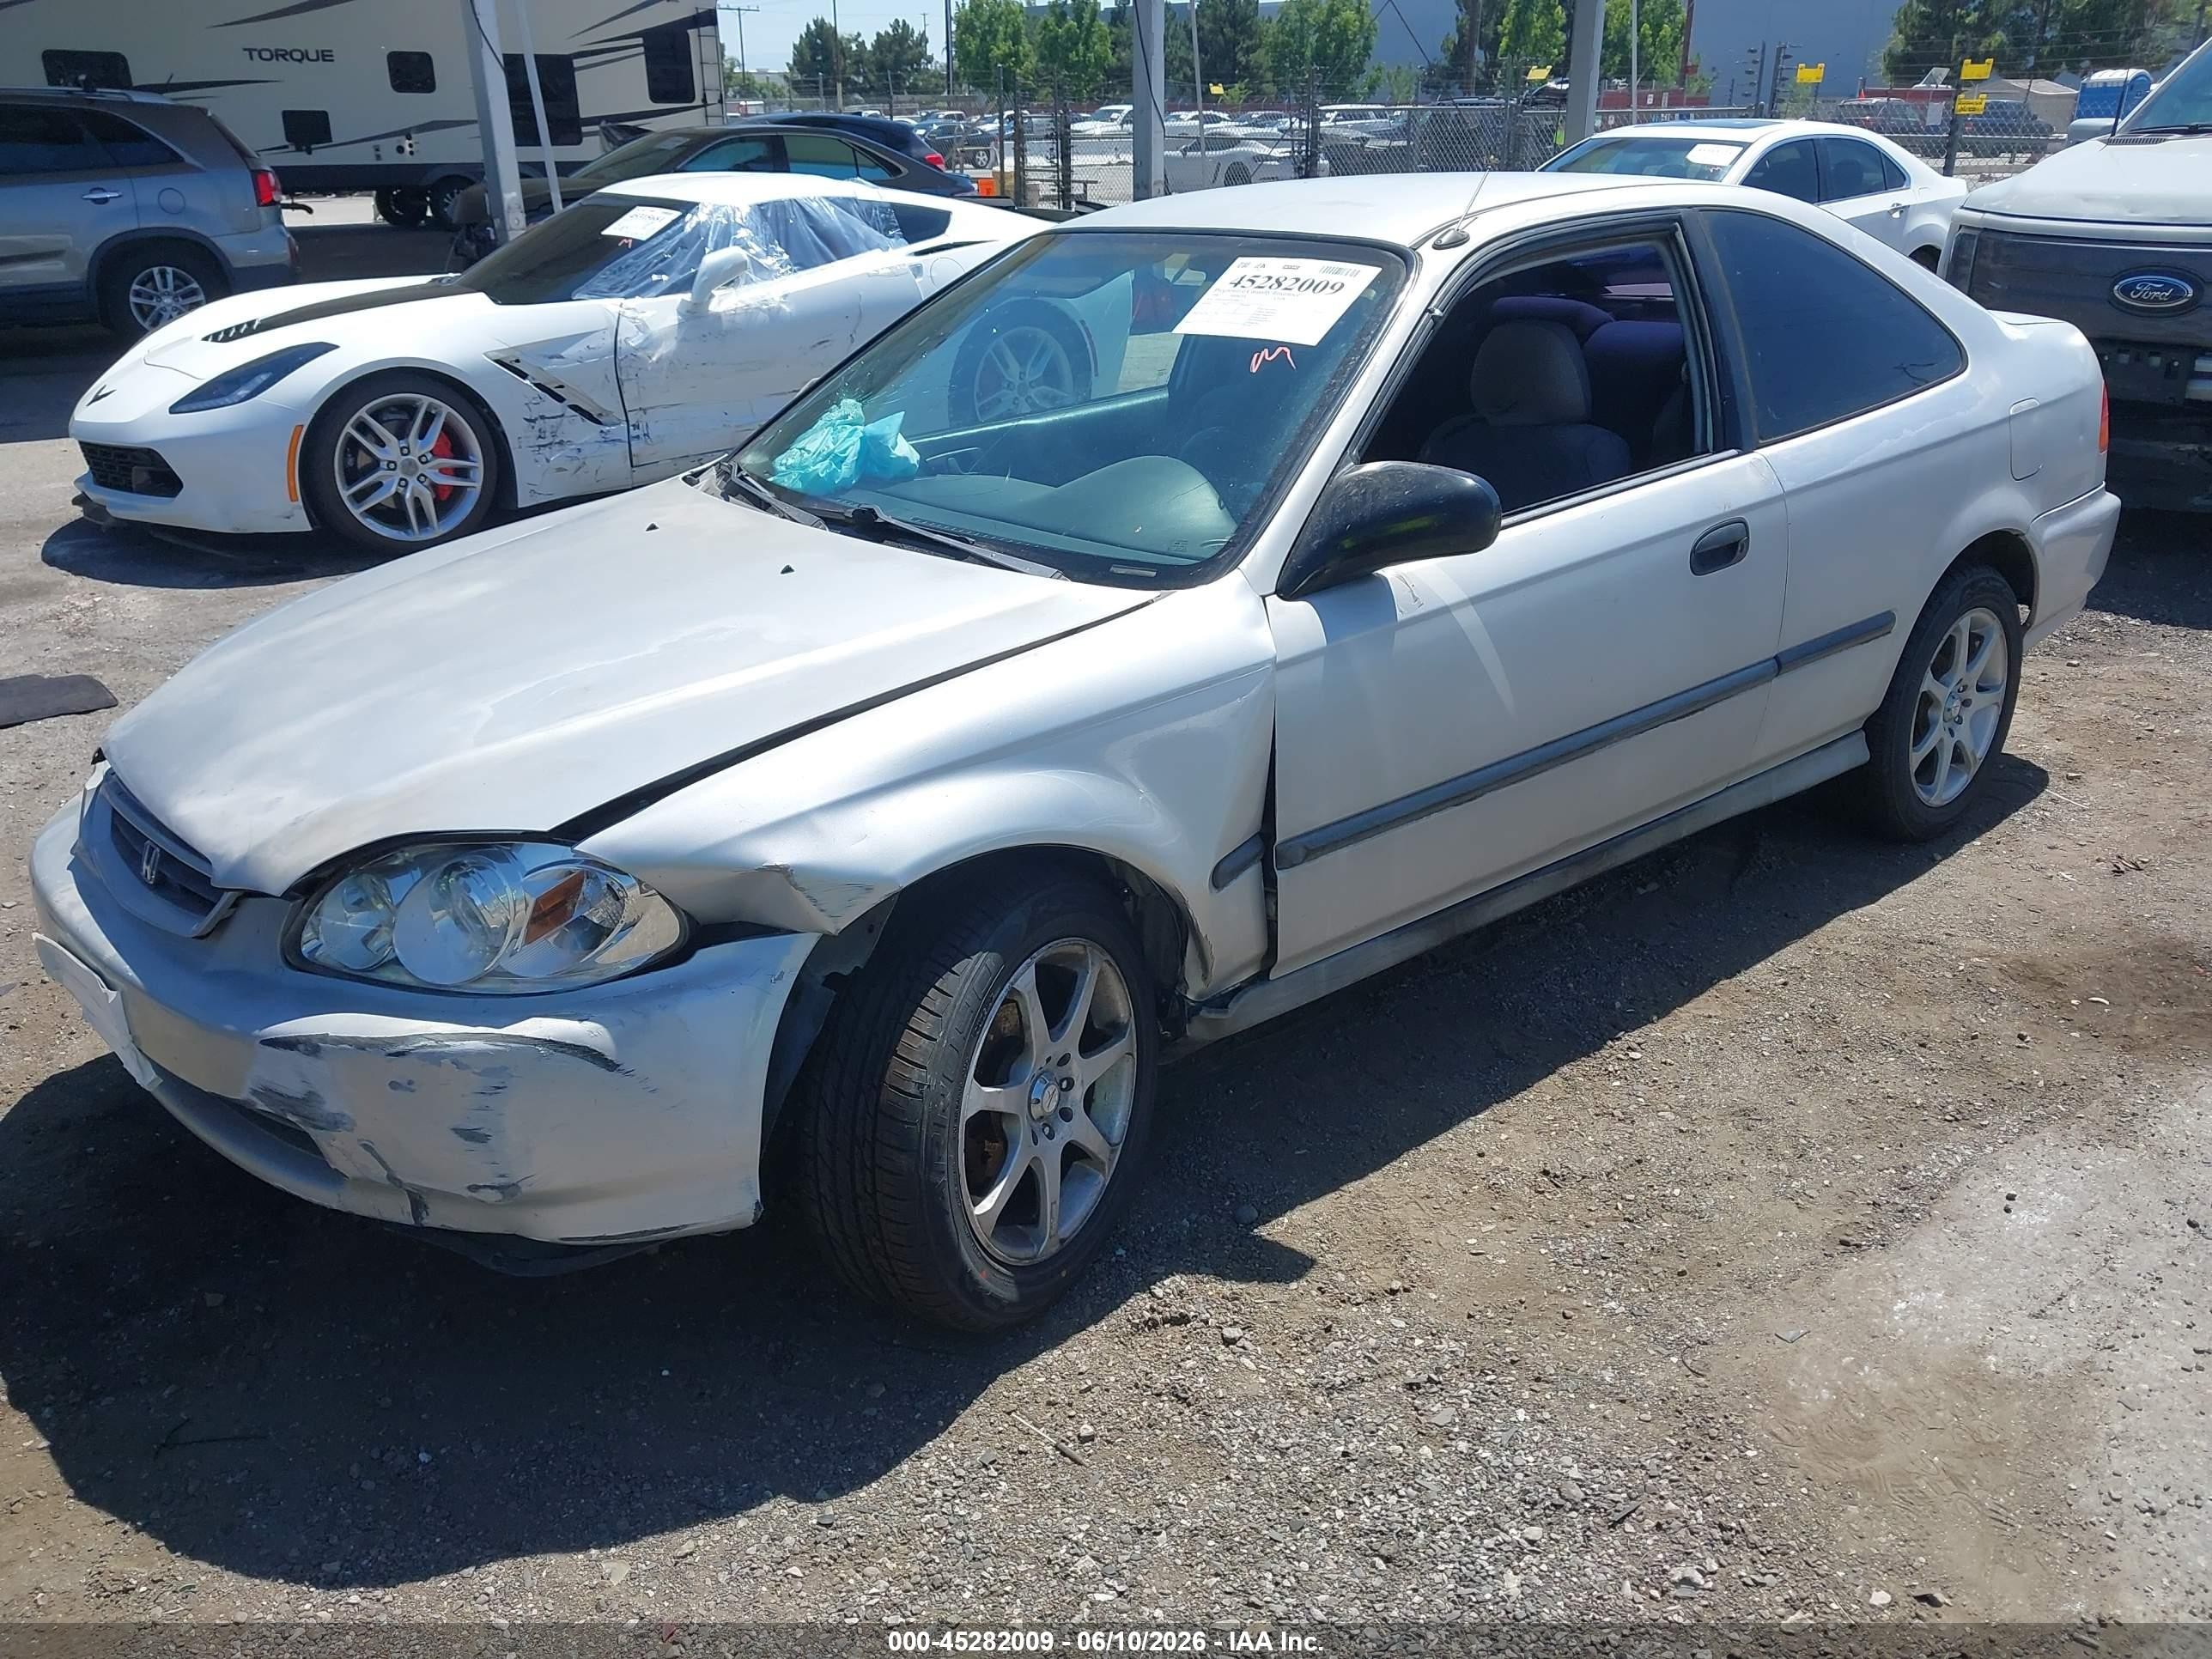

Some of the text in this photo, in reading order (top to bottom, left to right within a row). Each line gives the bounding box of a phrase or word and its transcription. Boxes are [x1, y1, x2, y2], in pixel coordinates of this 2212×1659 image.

[242, 48, 335, 64] TORQUE
[1230, 274, 1346, 295] 45282009
[2130, 282, 2174, 301] Ford
